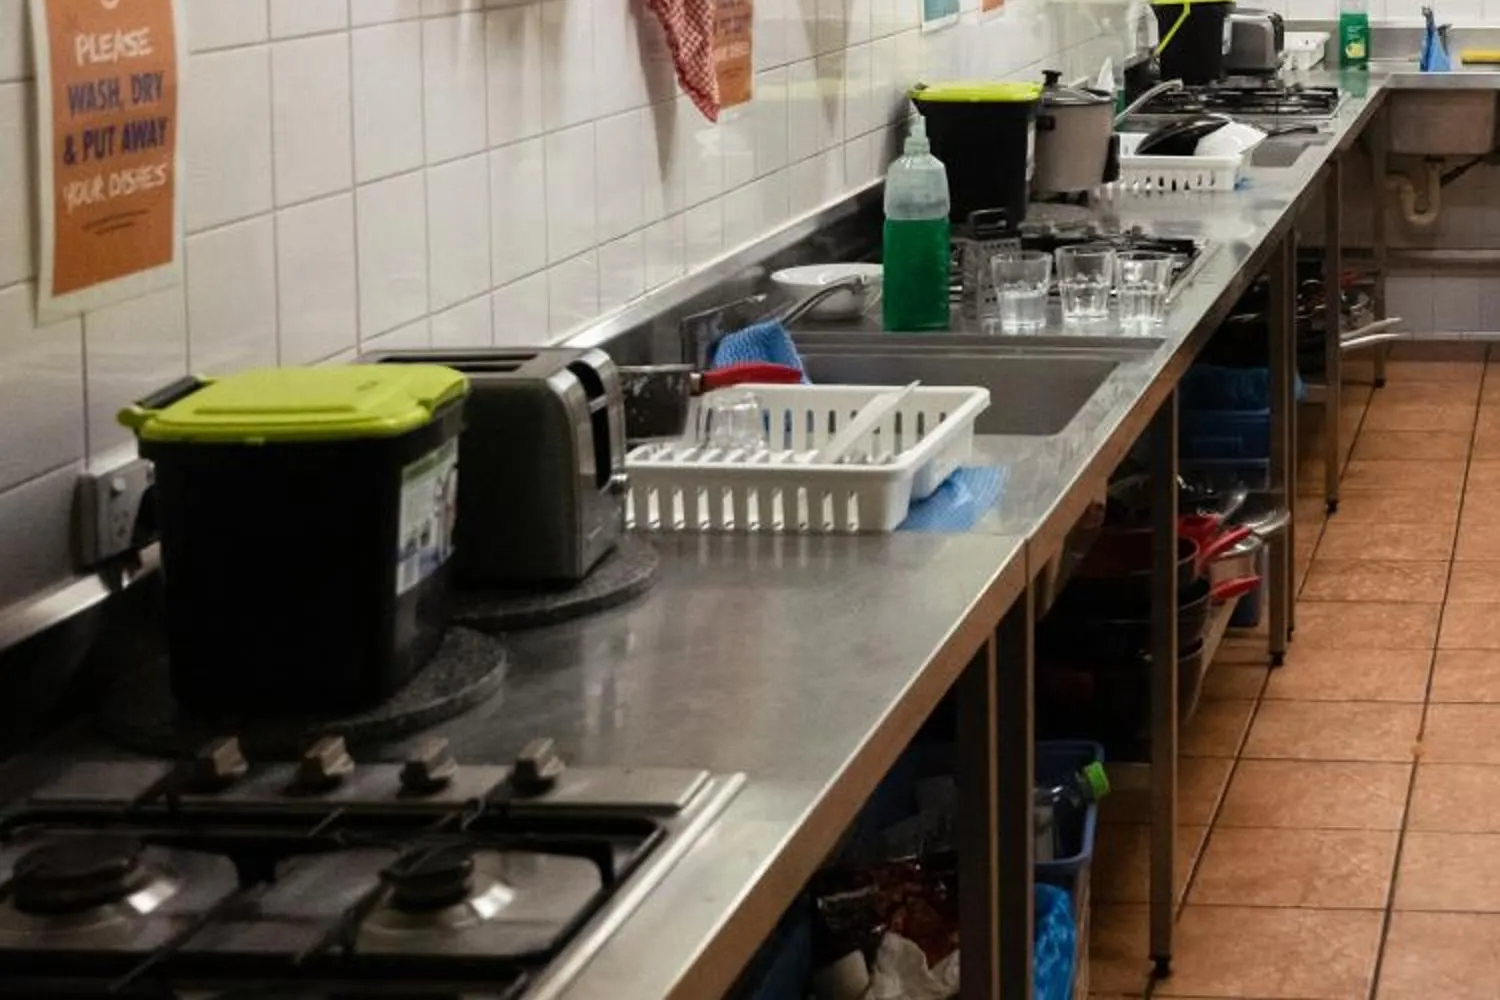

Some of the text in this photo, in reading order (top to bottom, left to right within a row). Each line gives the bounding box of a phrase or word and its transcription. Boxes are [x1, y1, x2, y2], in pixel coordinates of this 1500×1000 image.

[75, 27, 153, 66] PLEASE
[67, 70, 165, 116] WASH, DRY
[63, 115, 168, 166] & PUT AWAY
[63, 162, 168, 214] YOUR DISHES
